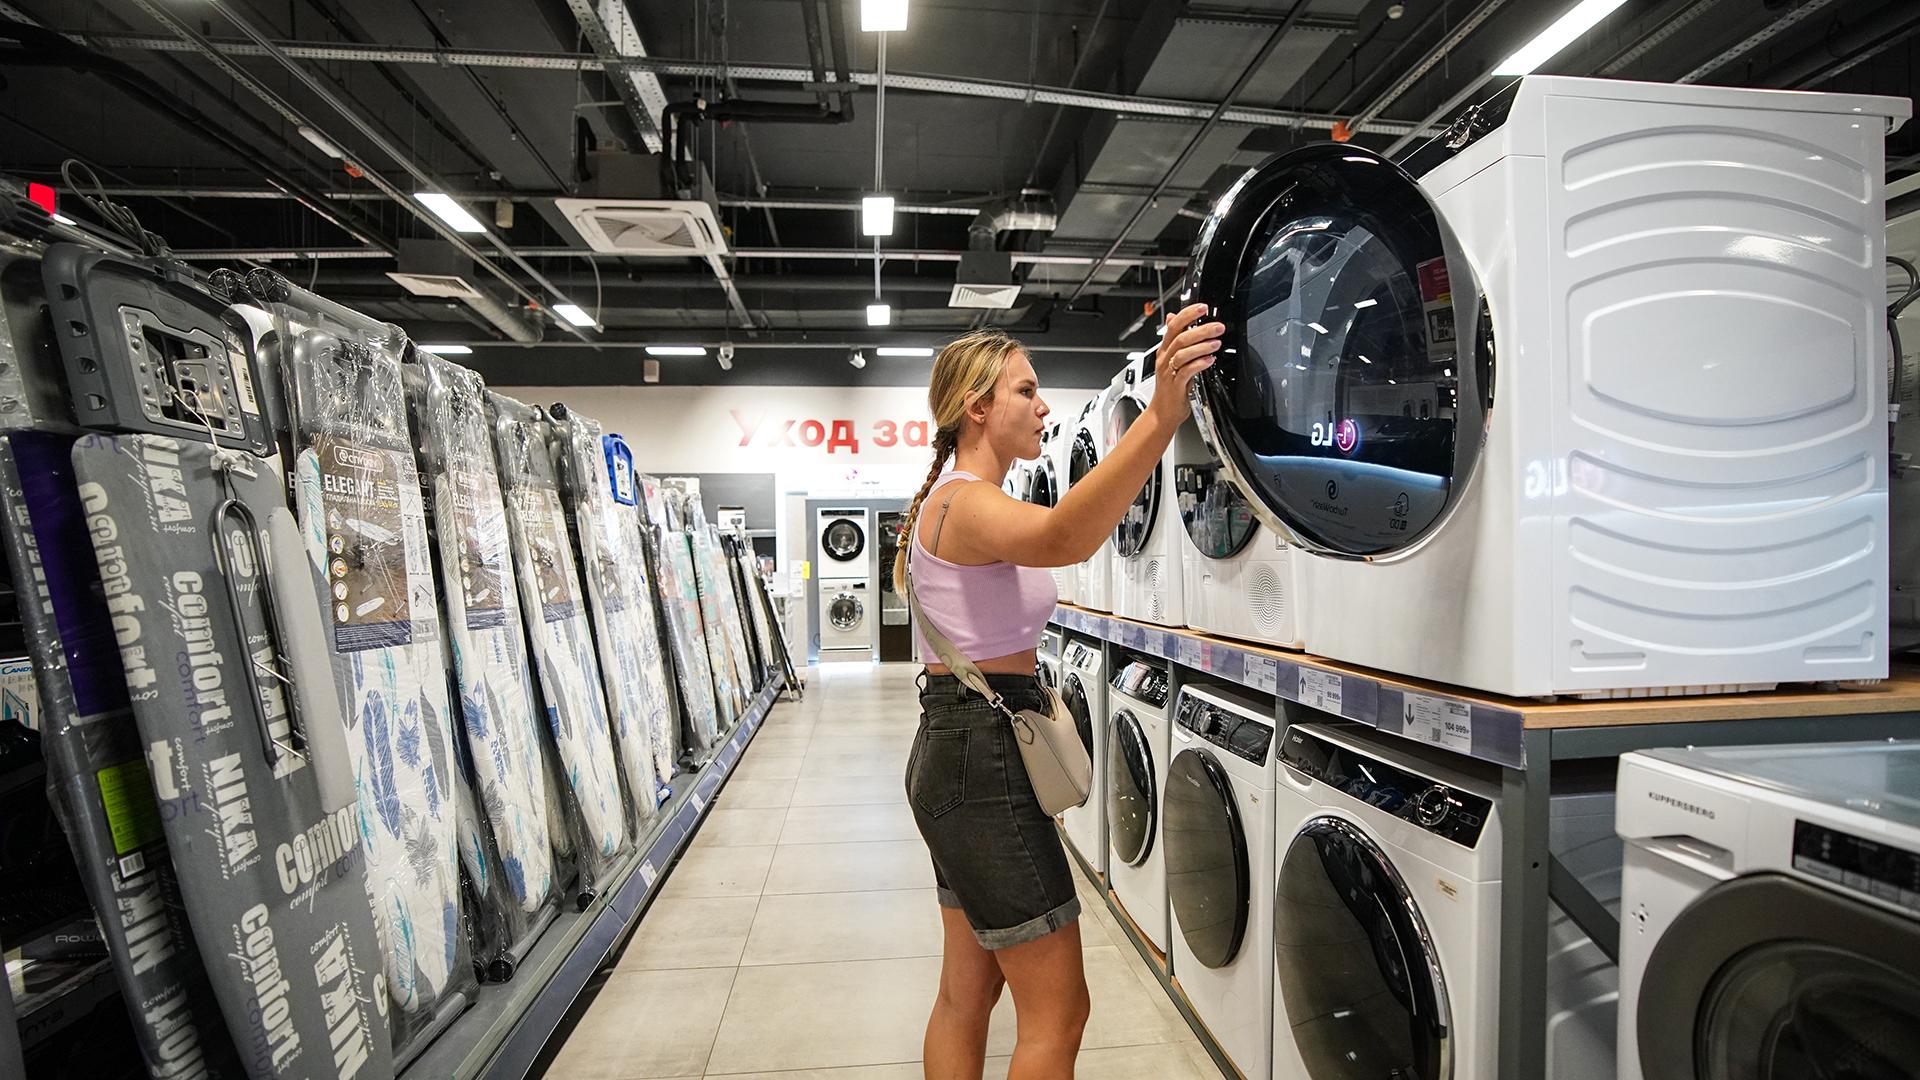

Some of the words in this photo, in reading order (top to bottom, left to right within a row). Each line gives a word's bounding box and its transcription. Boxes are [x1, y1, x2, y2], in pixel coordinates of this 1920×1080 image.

[729, 409, 859, 454] Уход
[872, 419, 928, 447] за
[324, 474, 375, 499] ELEGANT
[158, 576, 185, 638] comfort
[173, 571, 232, 726] comfort
[205, 720, 234, 736] comfort
[173, 737, 191, 791] comfort
[208, 752, 258, 867] NIKA
[1649, 791, 1716, 820] KUPPERSBERG
[232, 854, 262, 876] comfort
[275, 801, 361, 895] comfor
[289, 868, 329, 914] comfort
[228, 923, 253, 983] comfort
[310, 922, 340, 955] comfort
[242, 903, 300, 1067] comfort
[314, 933, 369, 1080] NIKA
